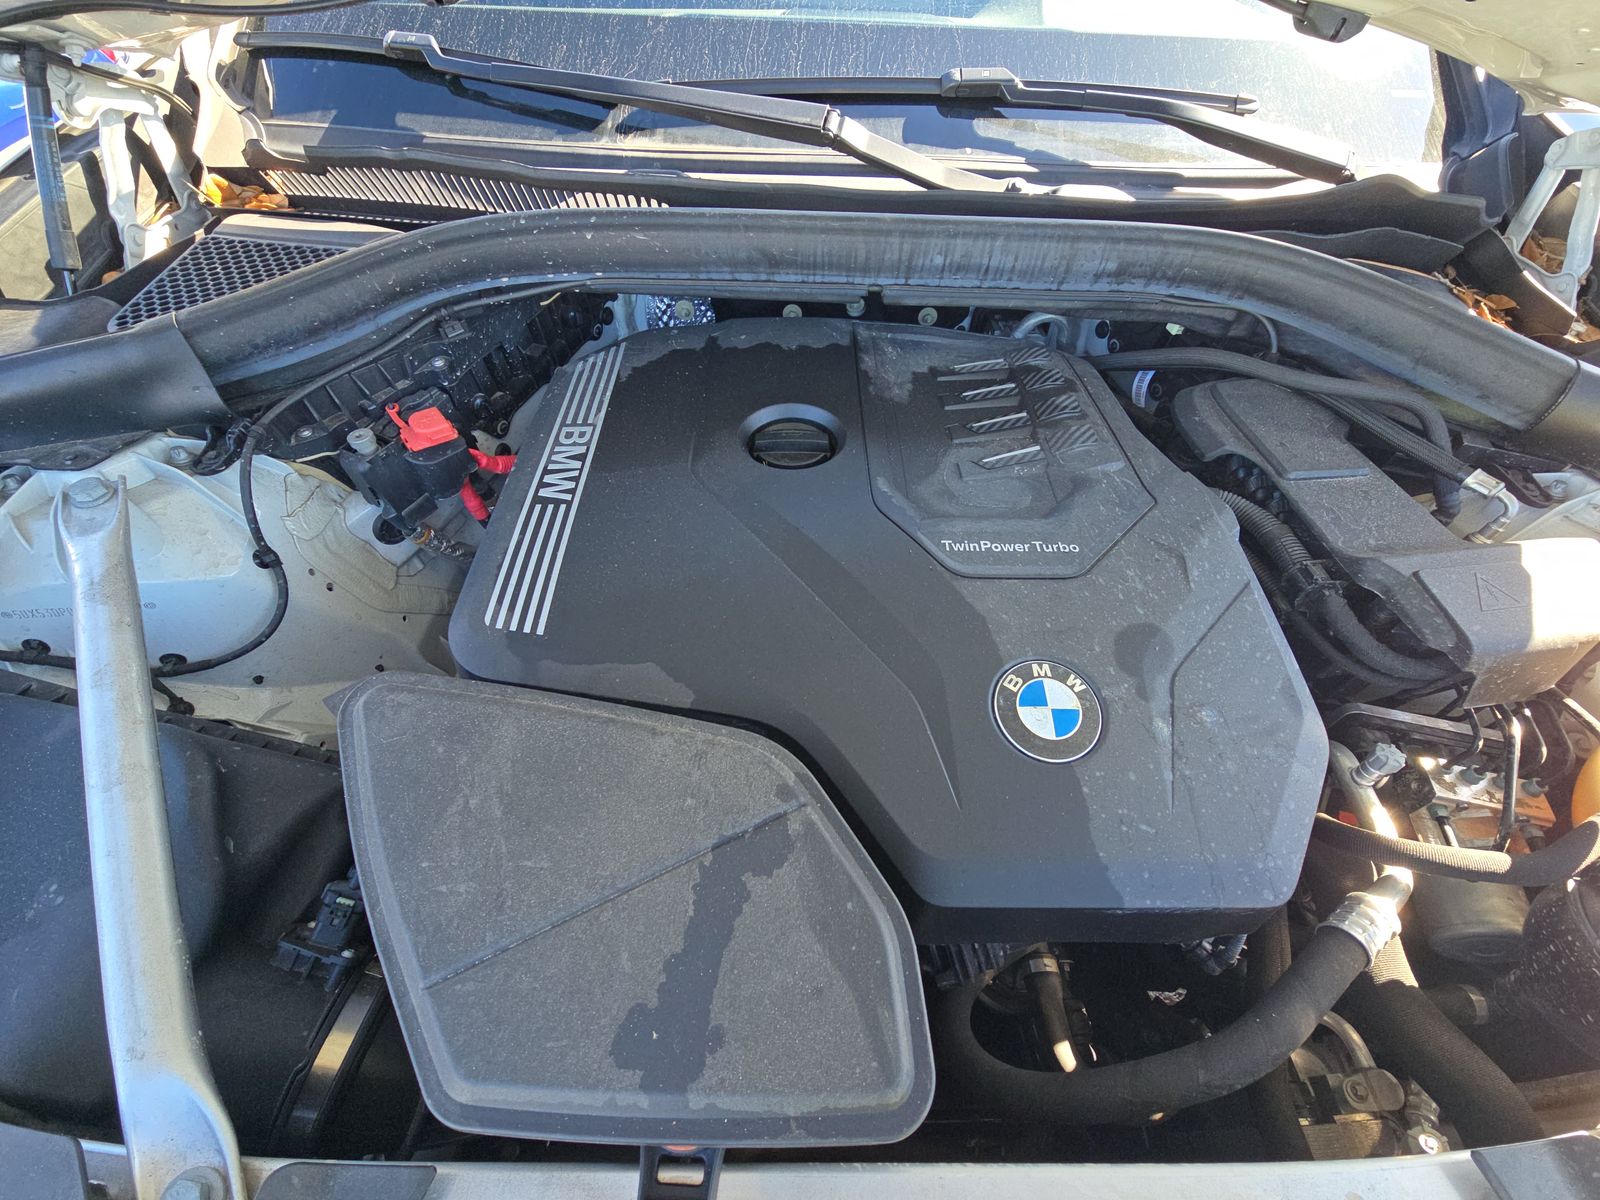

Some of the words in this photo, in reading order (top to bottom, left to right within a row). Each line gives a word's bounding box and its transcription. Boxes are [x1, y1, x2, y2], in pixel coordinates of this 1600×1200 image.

[537, 426, 594, 501] BMW
[940, 540, 1030, 552] TwinPower
[1031, 541, 1080, 553] Turbo
[1003, 663, 1087, 693] BMW
